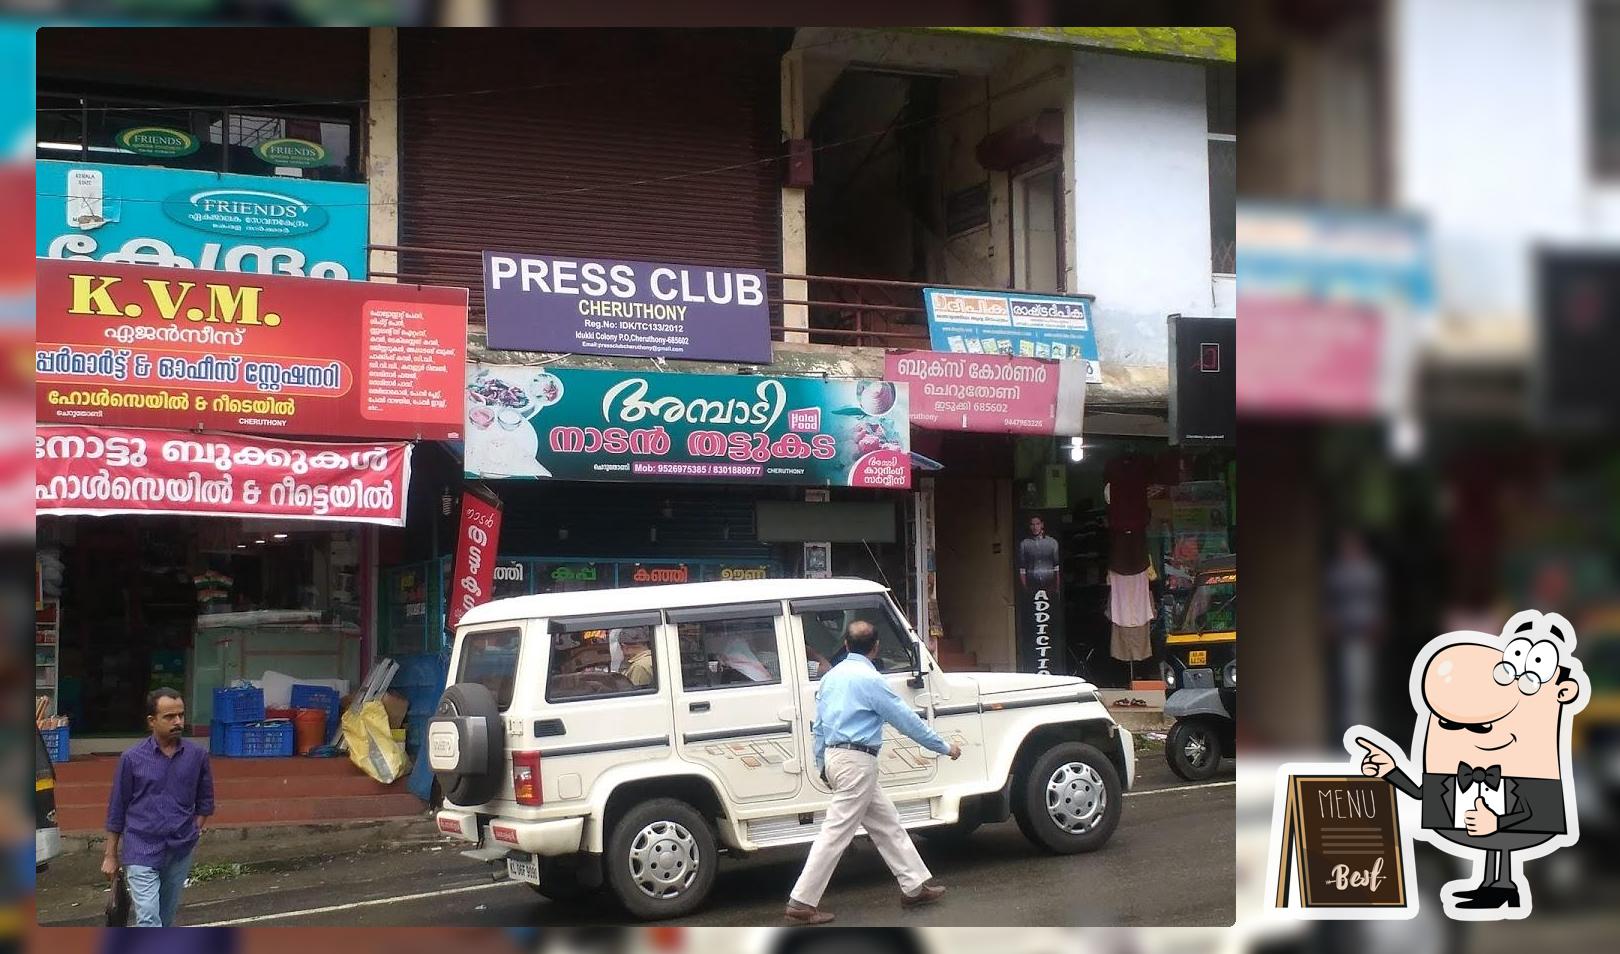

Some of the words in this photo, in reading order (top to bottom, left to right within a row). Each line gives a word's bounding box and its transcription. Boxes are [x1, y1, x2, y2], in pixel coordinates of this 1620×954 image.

[134, 135, 182, 145] FRIENDS
[271, 146, 316, 156] FRIENDS
[204, 199, 298, 217] FRIENDS
[491, 256, 637, 298] PRESS
[650, 267, 764, 306] CLUB
[68, 274, 282, 327] K.V.M.
[578, 299, 687, 321] CHERUTHONY
[104, 324, 245, 346] ഏജൻസീസ്
[584, 319, 617, 329] Reg.No:
[619, 321, 684, 333] IDK/TC133/2012
[575, 331, 594, 339] Idukki
[595, 332, 617, 342] Colony
[134, 354, 152, 377] &
[158, 353, 241, 384] ഓഫീസ്
[245, 360, 341, 392] സ്റ്റേഷനറി
[898, 358, 966, 380] ബുക്സ്
[968, 363, 1046, 383] കോർണർ
[48, 388, 190, 410] ഹോൾസെയിൽ
[195, 396, 207, 409] &
[924, 383, 1020, 400] ചെറുതോണി
[602, 378, 787, 434] അമ്പാടി
[935, 400, 971, 412] ഇടുക്കി
[238, 418, 287, 427] CHERUTHONY
[791, 412, 818, 423] Halal
[791, 422, 818, 430] Food
[549, 425, 671, 457] നാടൻ
[687, 429, 837, 463] തട്ടുകട
[162, 437, 389, 474] ബുക്കുകൾ
[634, 464, 656, 473] Mob:
[657, 464, 707, 474] 9526975385
[713, 466, 761, 475] 8301880977
[766, 467, 804, 475] CHERUTHONY
[242, 484, 262, 505] &
[269, 479, 394, 514] റീട്ടെയിൽ
[494, 562, 523, 581] ത്തി
